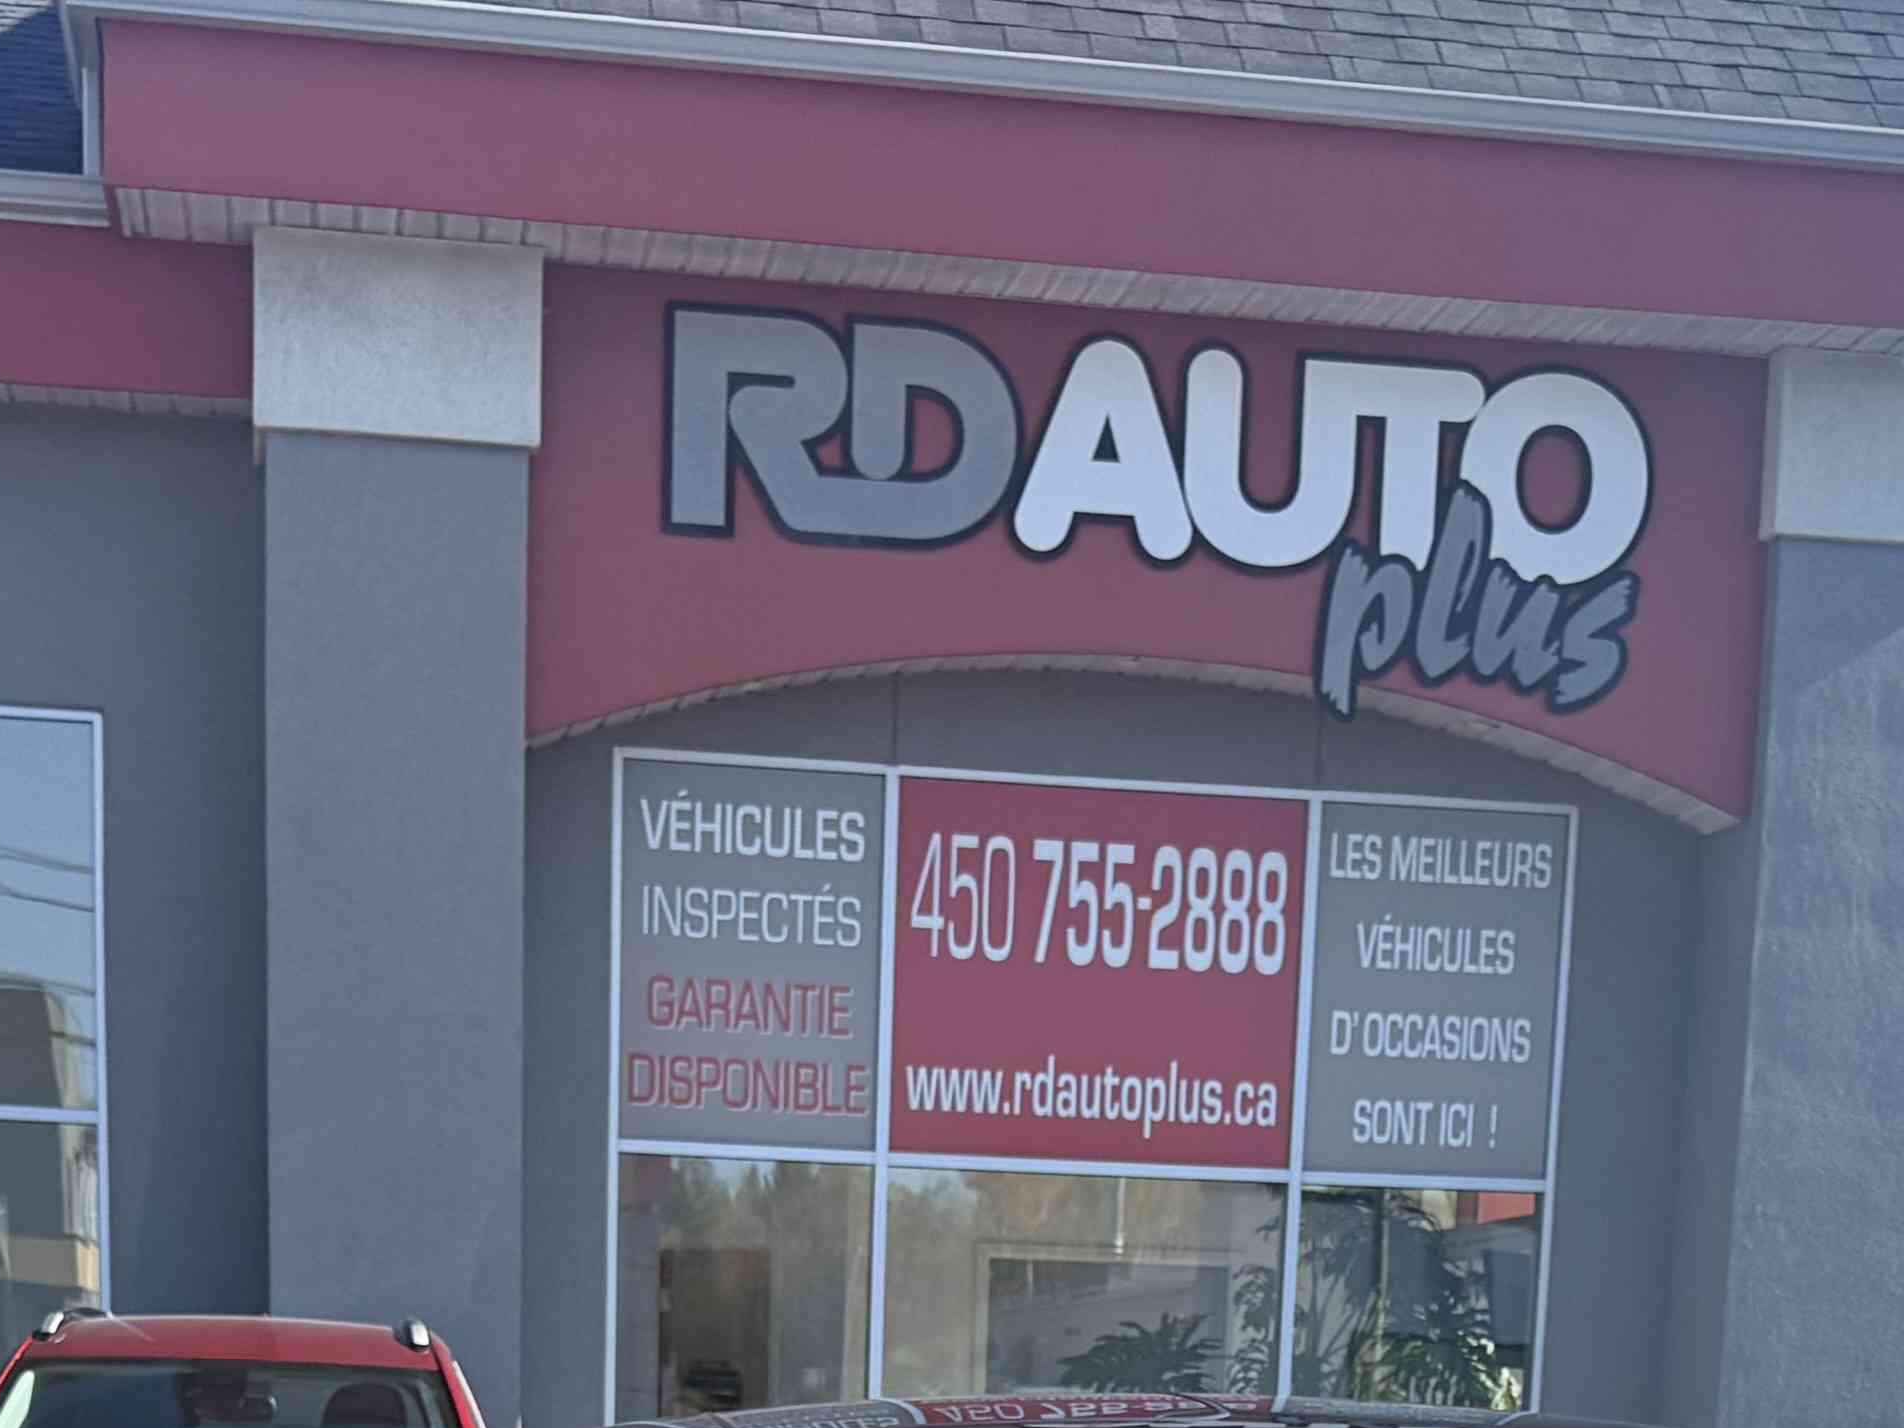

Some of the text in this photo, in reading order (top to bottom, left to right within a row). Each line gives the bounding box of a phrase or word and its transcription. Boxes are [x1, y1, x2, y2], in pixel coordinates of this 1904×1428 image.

[1316, 480, 1640, 717] plus
[640, 789, 866, 863] VÉHICULES
[1329, 832, 1553, 889] LES MEILLEURS
[642, 883, 862, 947] INSPECTÉS
[910, 832, 1289, 976] 450 755-2888
[1356, 913, 1516, 975] VÉHICULES
[647, 974, 854, 1039] GARANTIE
[627, 1051, 871, 1117] DISPONIBLE
[905, 1053, 1279, 1140] www.rdautoplus.ca
[1352, 1098, 1434, 1145] SONT
